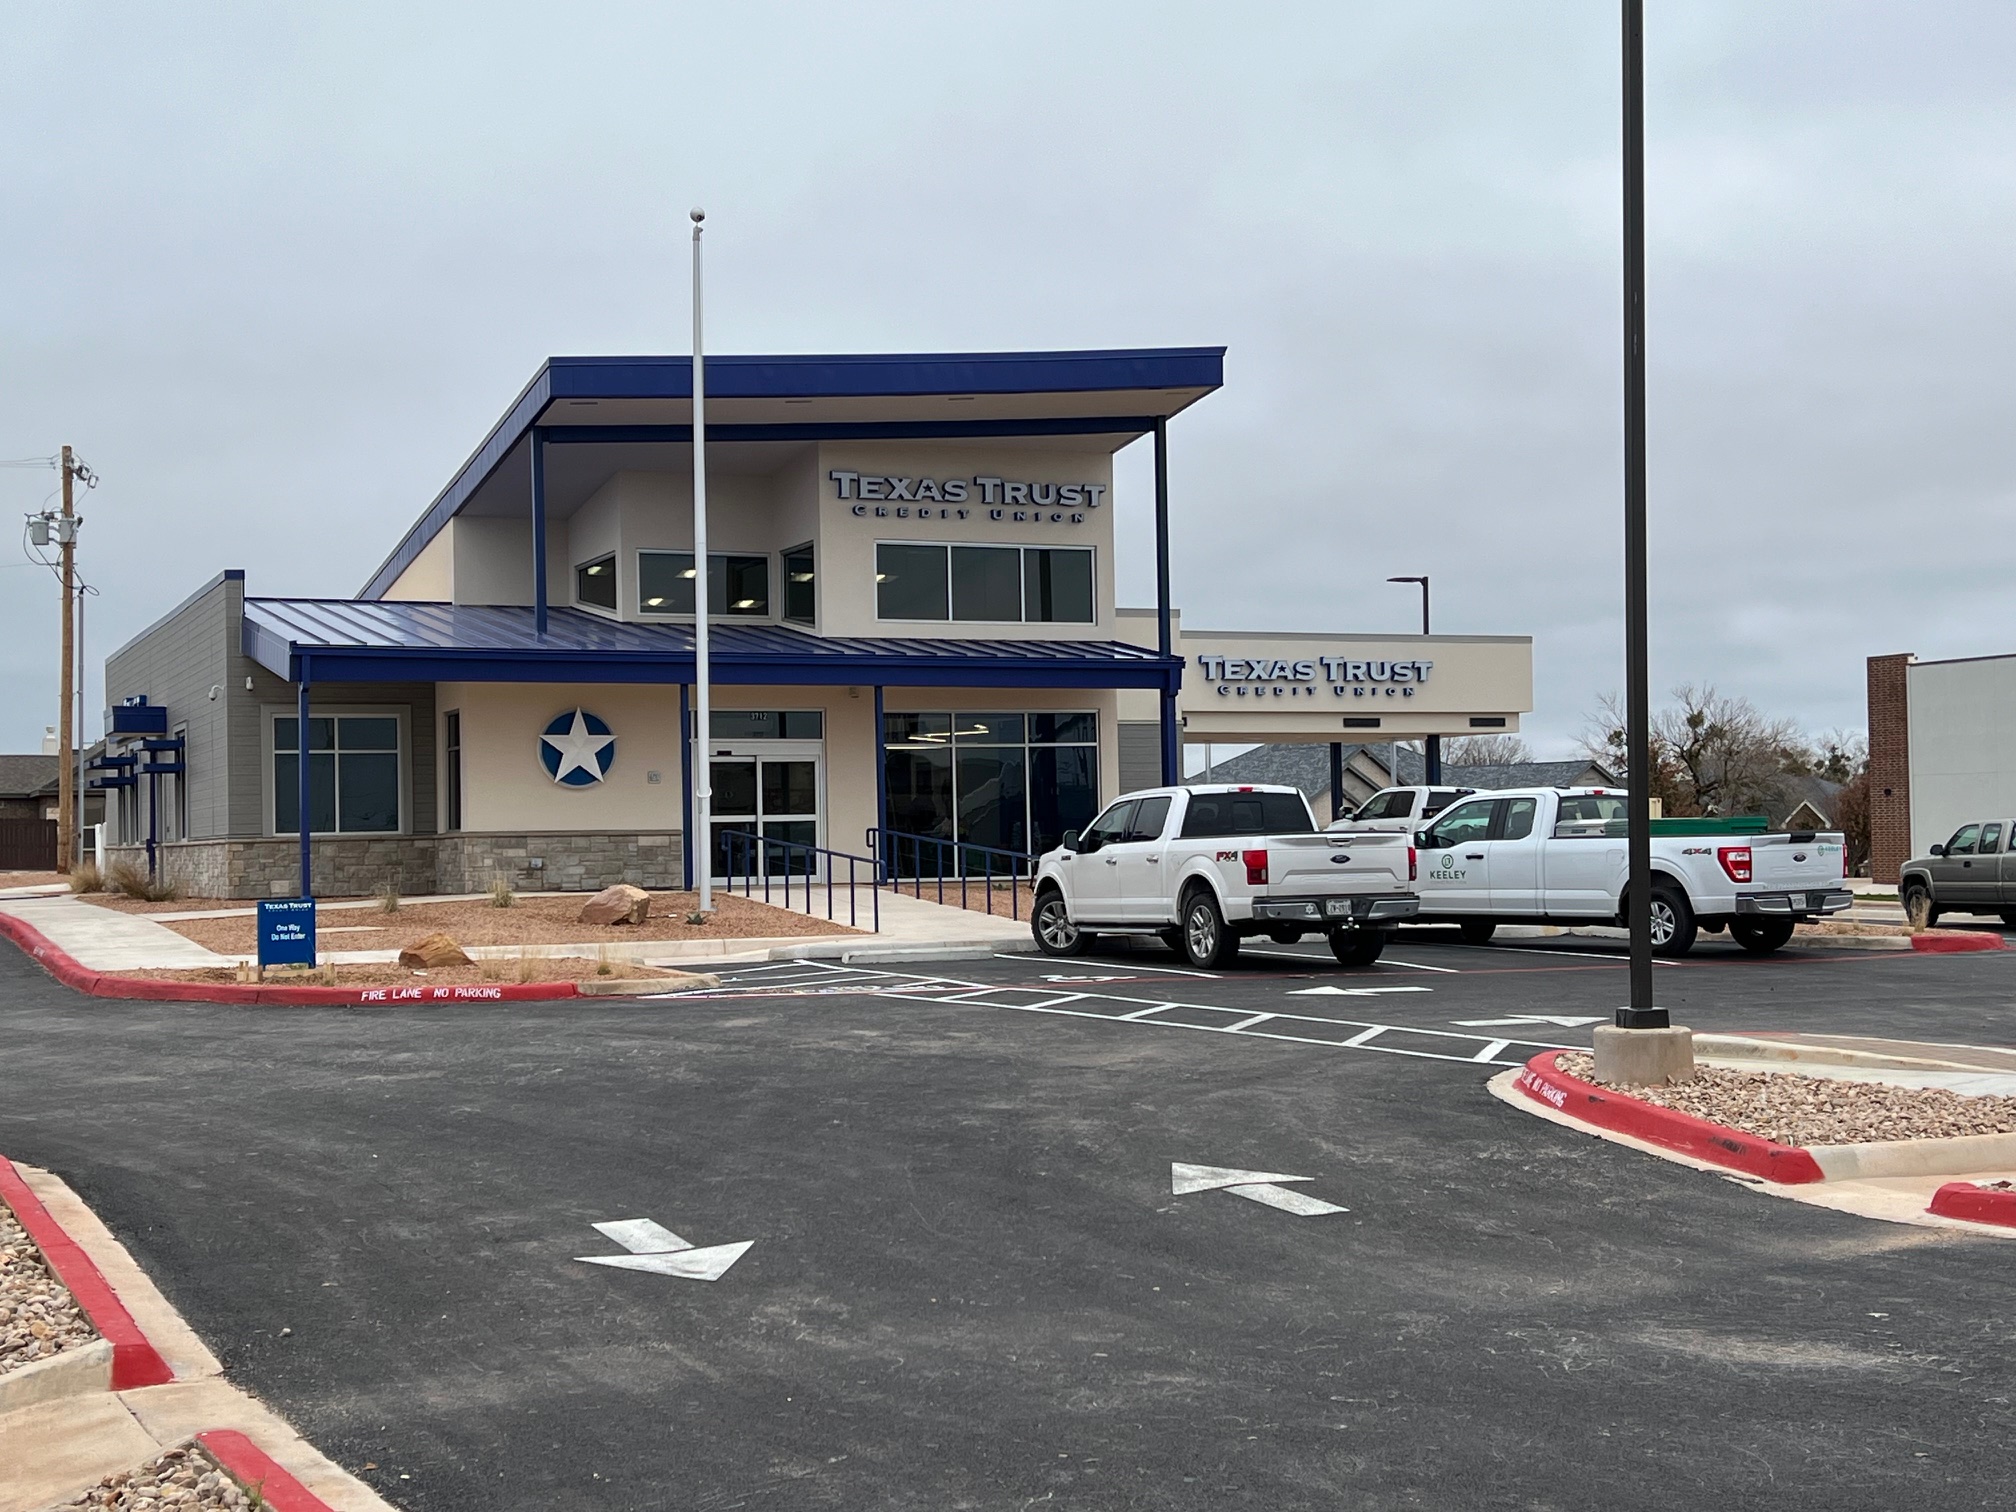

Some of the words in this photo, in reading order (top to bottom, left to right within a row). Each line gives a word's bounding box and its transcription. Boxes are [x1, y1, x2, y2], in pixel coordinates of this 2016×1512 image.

[829, 471, 969, 502] TEXAS
[973, 475, 1106, 508] TRUST
[853, 504, 969, 519] CREDIT
[990, 508, 1085, 523] UNION
[1198, 655, 1317, 681] TEXAS
[1320, 656, 1433, 683] TRUST
[1218, 685, 1317, 696] CREDIT
[1333, 685, 1415, 696] UNION
[1216, 851, 1238, 862] FX4
[1429, 870, 1466, 879] KEELEY
[361, 990, 387, 1001] FIRE
[392, 987, 423, 999] LANE
[433, 988, 449, 998] NO
[455, 988, 501, 998] PARKING
